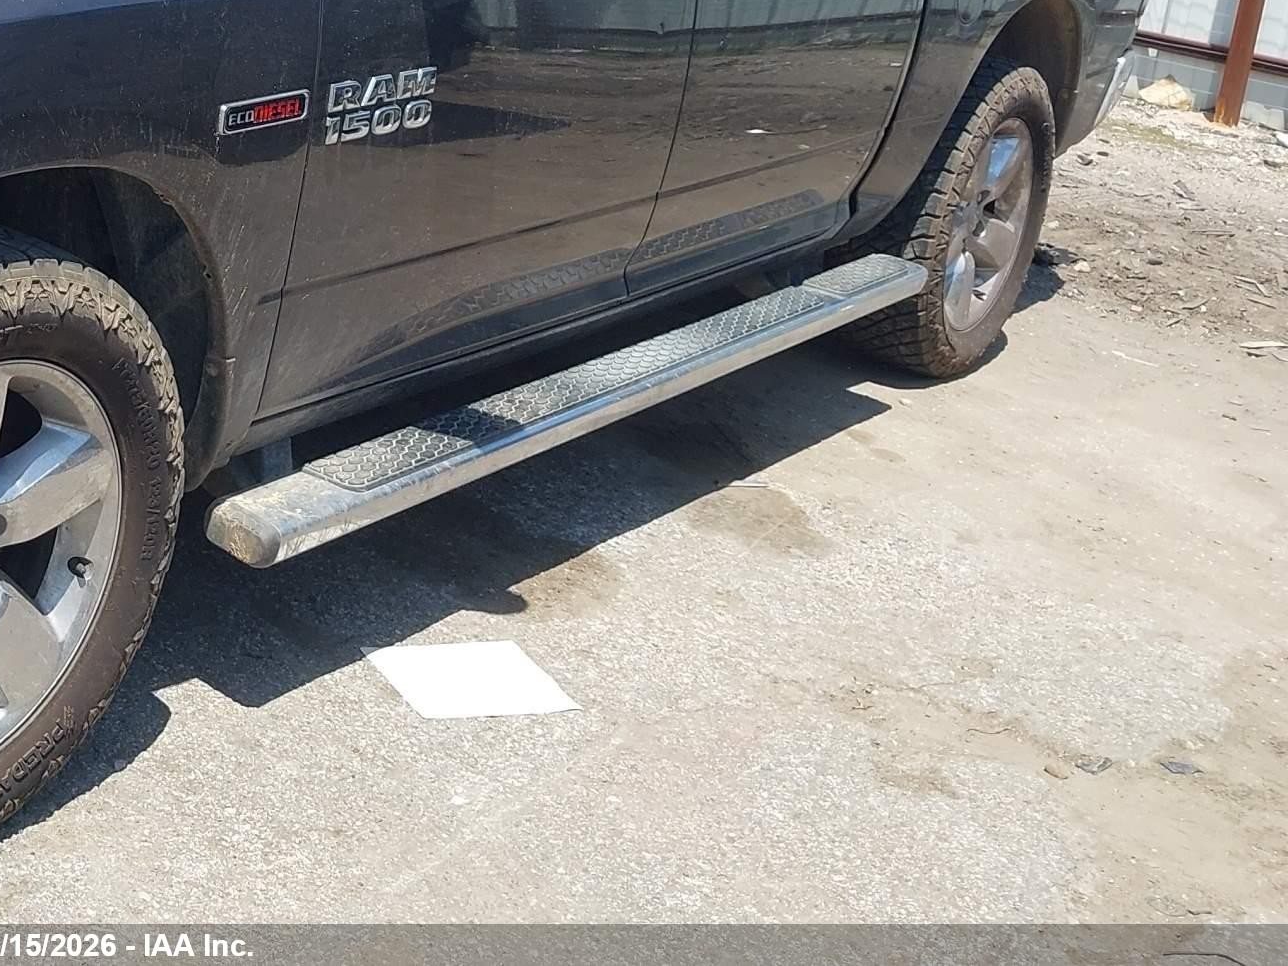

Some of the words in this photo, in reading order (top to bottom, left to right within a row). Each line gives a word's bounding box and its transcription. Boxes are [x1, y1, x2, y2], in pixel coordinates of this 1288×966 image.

[228, 97, 300, 126] ECODIESEL
[327, 66, 438, 113] RAM
[324, 98, 433, 146] 1500
